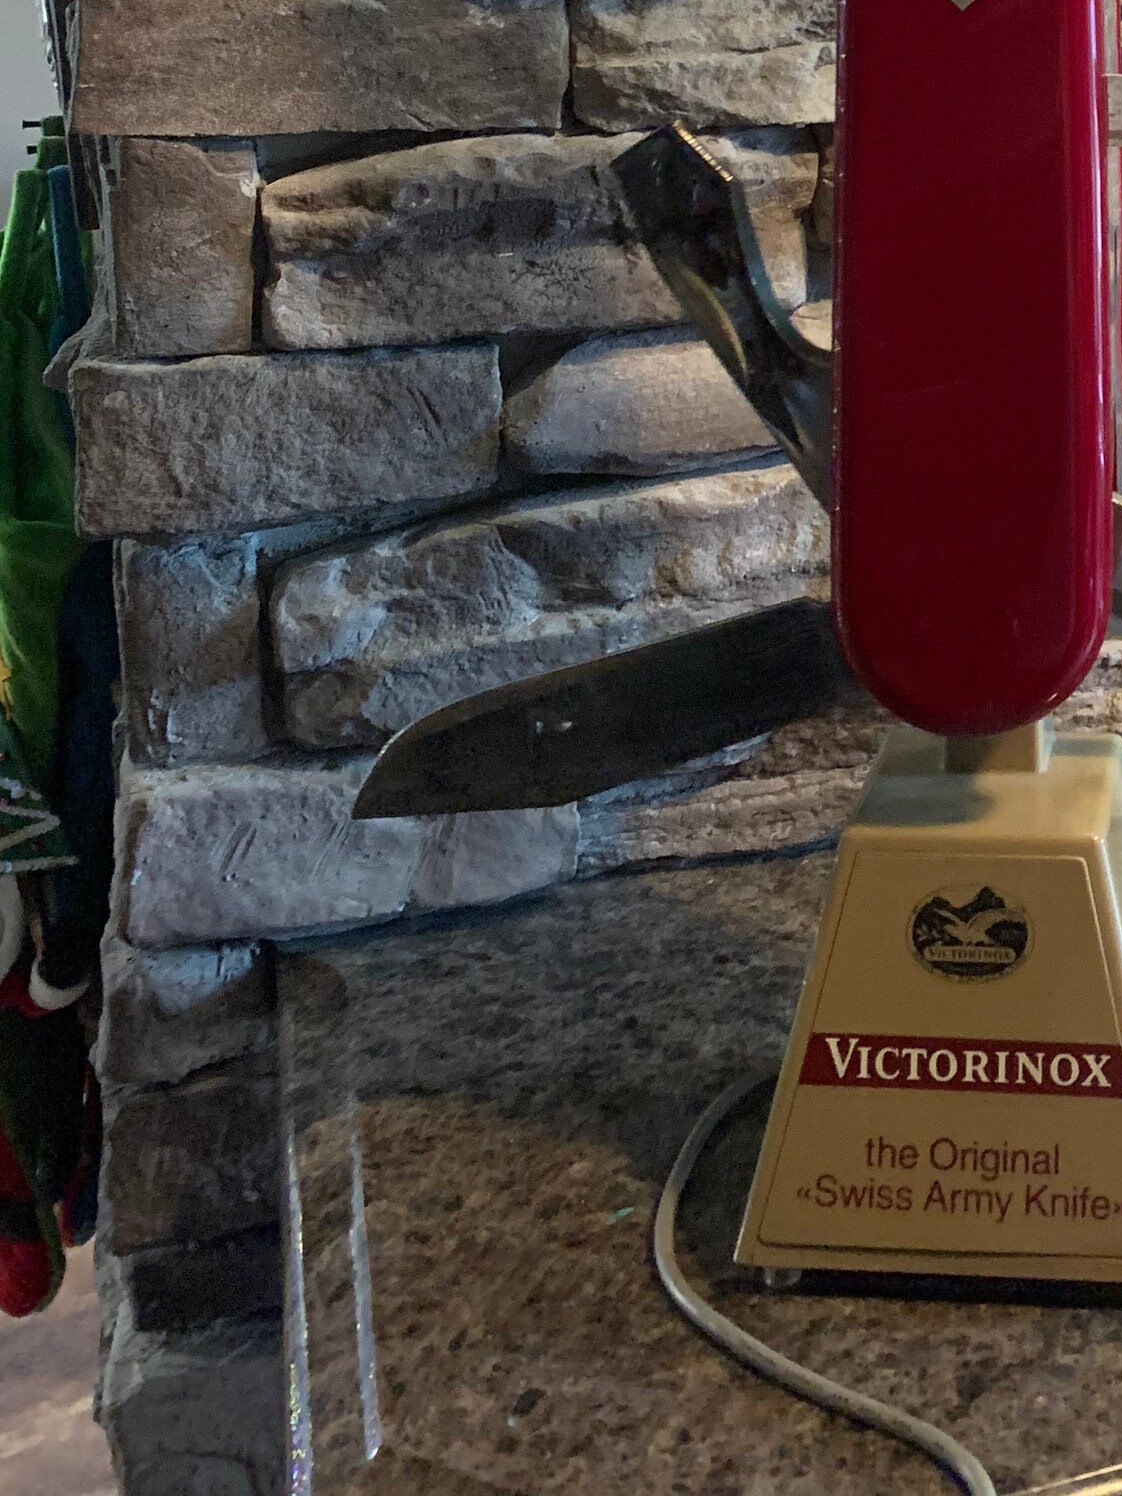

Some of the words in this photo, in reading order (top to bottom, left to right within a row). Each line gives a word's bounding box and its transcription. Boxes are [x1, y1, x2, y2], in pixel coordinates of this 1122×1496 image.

[824, 1037, 1112, 1088] VICTORINOX
[865, 1136, 919, 1169] the
[929, 1137, 1060, 1182] Original
[923, 1180, 1013, 1223] Army
